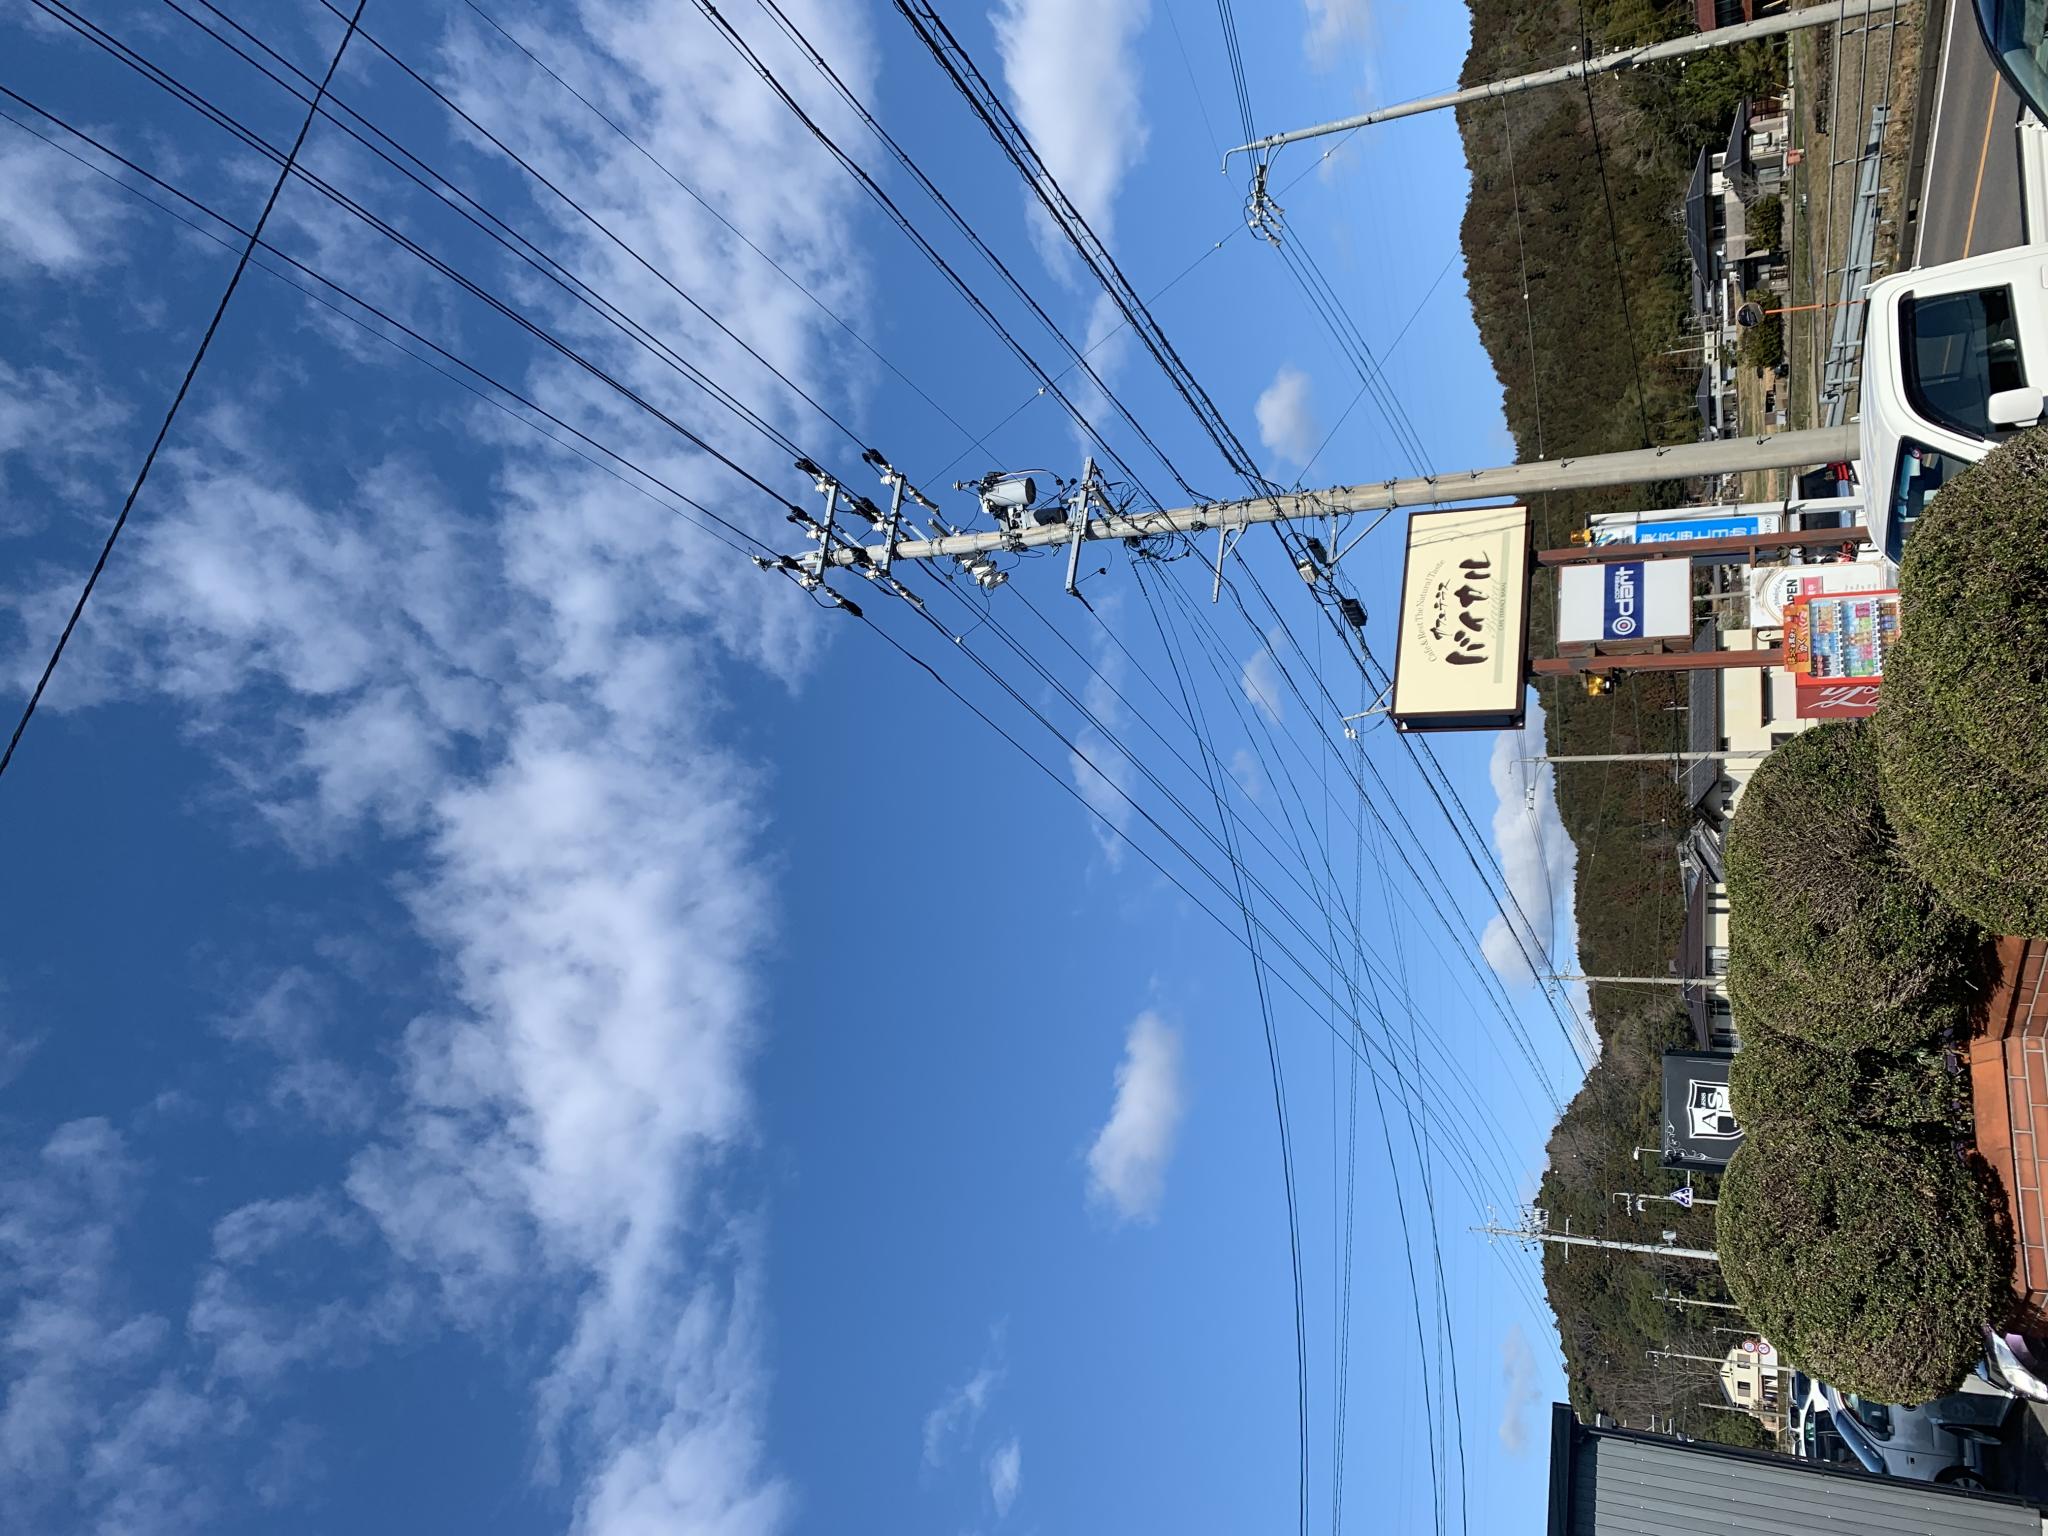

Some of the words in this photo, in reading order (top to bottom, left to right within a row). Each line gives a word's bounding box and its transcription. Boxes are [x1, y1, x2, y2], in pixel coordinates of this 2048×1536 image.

[1445, 551, 1491, 665] バイカル
[1615, 566, 1634, 616] dart
[1786, 579, 1797, 606] PEN
[1414, 608, 1424, 622] The
